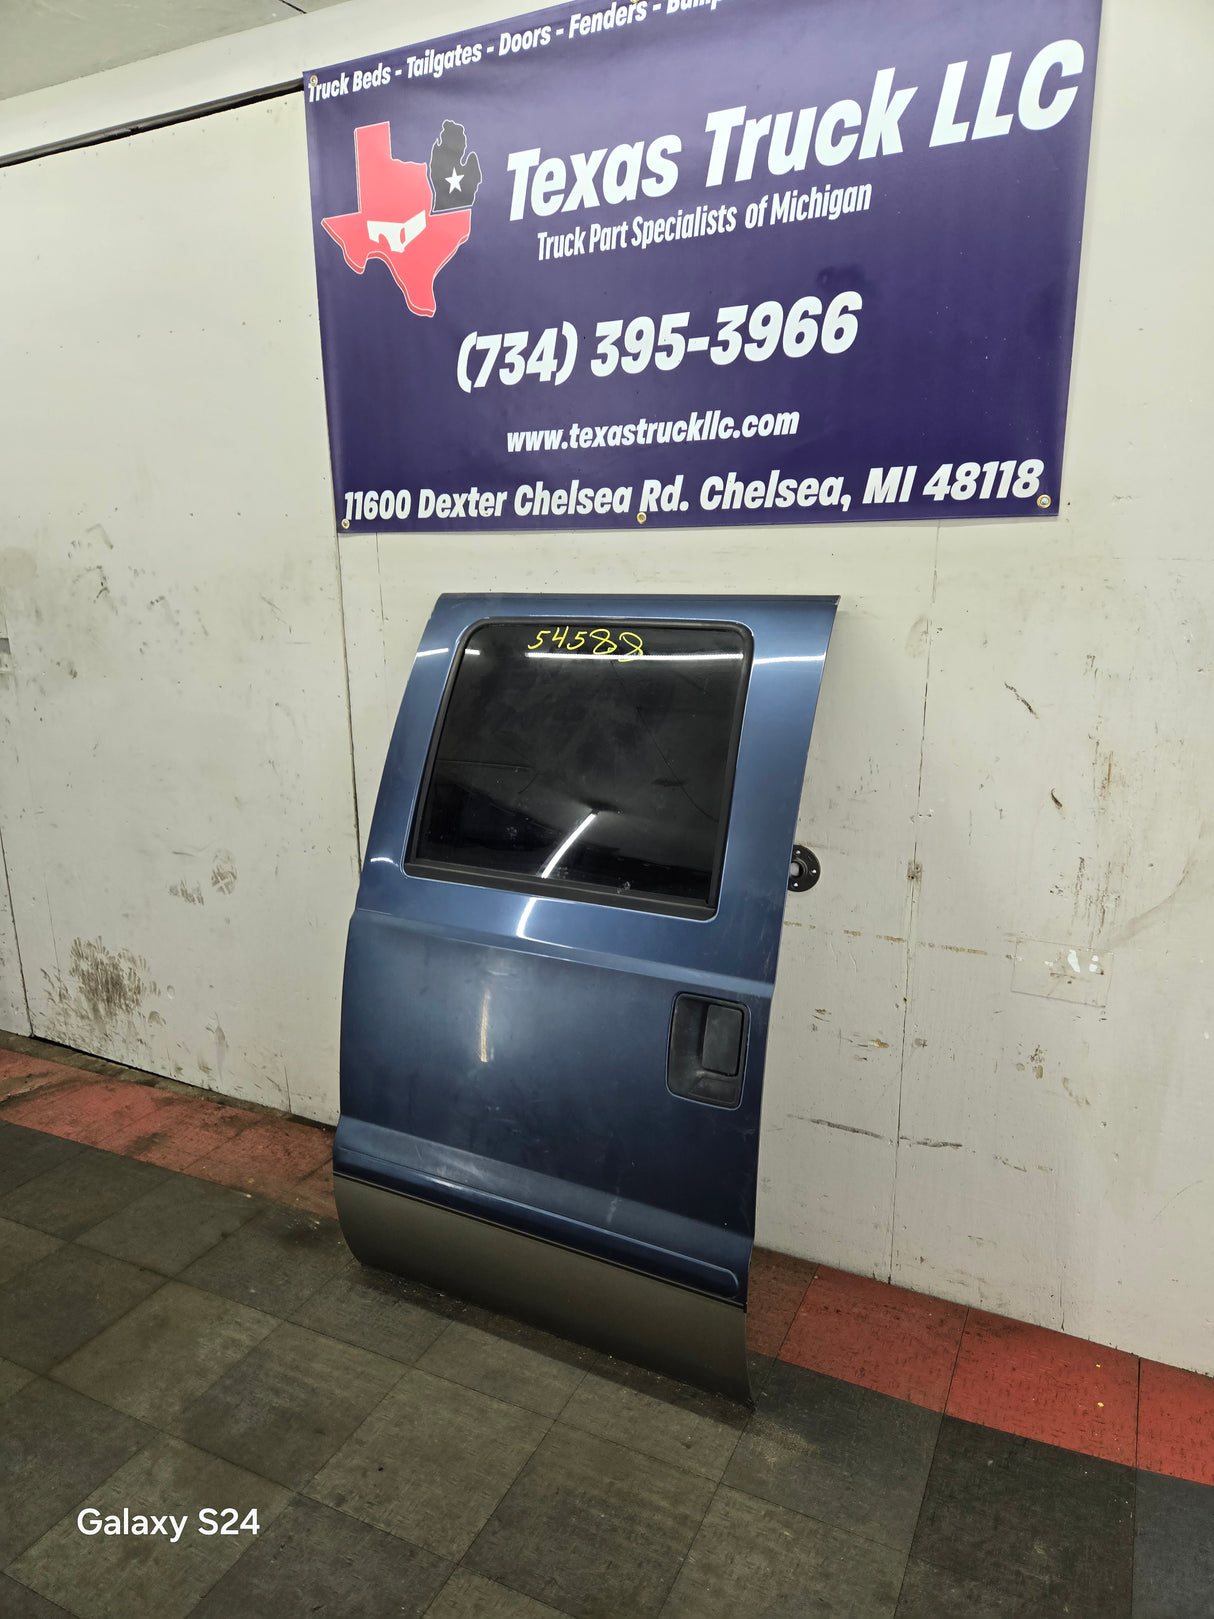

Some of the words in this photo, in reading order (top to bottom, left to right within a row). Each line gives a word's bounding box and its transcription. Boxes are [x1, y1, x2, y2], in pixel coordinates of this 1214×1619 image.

[308, 72, 350, 103] Truck
[353, 63, 392, 93] Beds
[407, 44, 483, 79] Tailgates
[499, 26, 552, 57] Doors
[568, 1, 648, 40] Fenders
[507, 134, 683, 222] Texas
[705, 66, 919, 188] Truck
[929, 38, 1085, 148] LLC
[538, 226, 586, 260] Truck
[589, 221, 628, 253] Part
[631, 205, 737, 249] Specialists
[745, 195, 768, 228] of
[770, 184, 872, 225] Michigan
[457, 321, 578, 393] (734)
[591, 291, 862, 377] 395-3966
[507, 410, 799, 452] www.texastruckllc.com
[344, 489, 412, 520] 11600
[418, 487, 507, 518] Dexter
[515, 480, 632, 516] Chelsea
[638, 475, 689, 512] Rd.
[700, 470, 851, 511] Chelsea,
[863, 466, 917, 503] MI
[922, 459, 1045, 501] 48118
[527, 625, 644, 662] 54588
